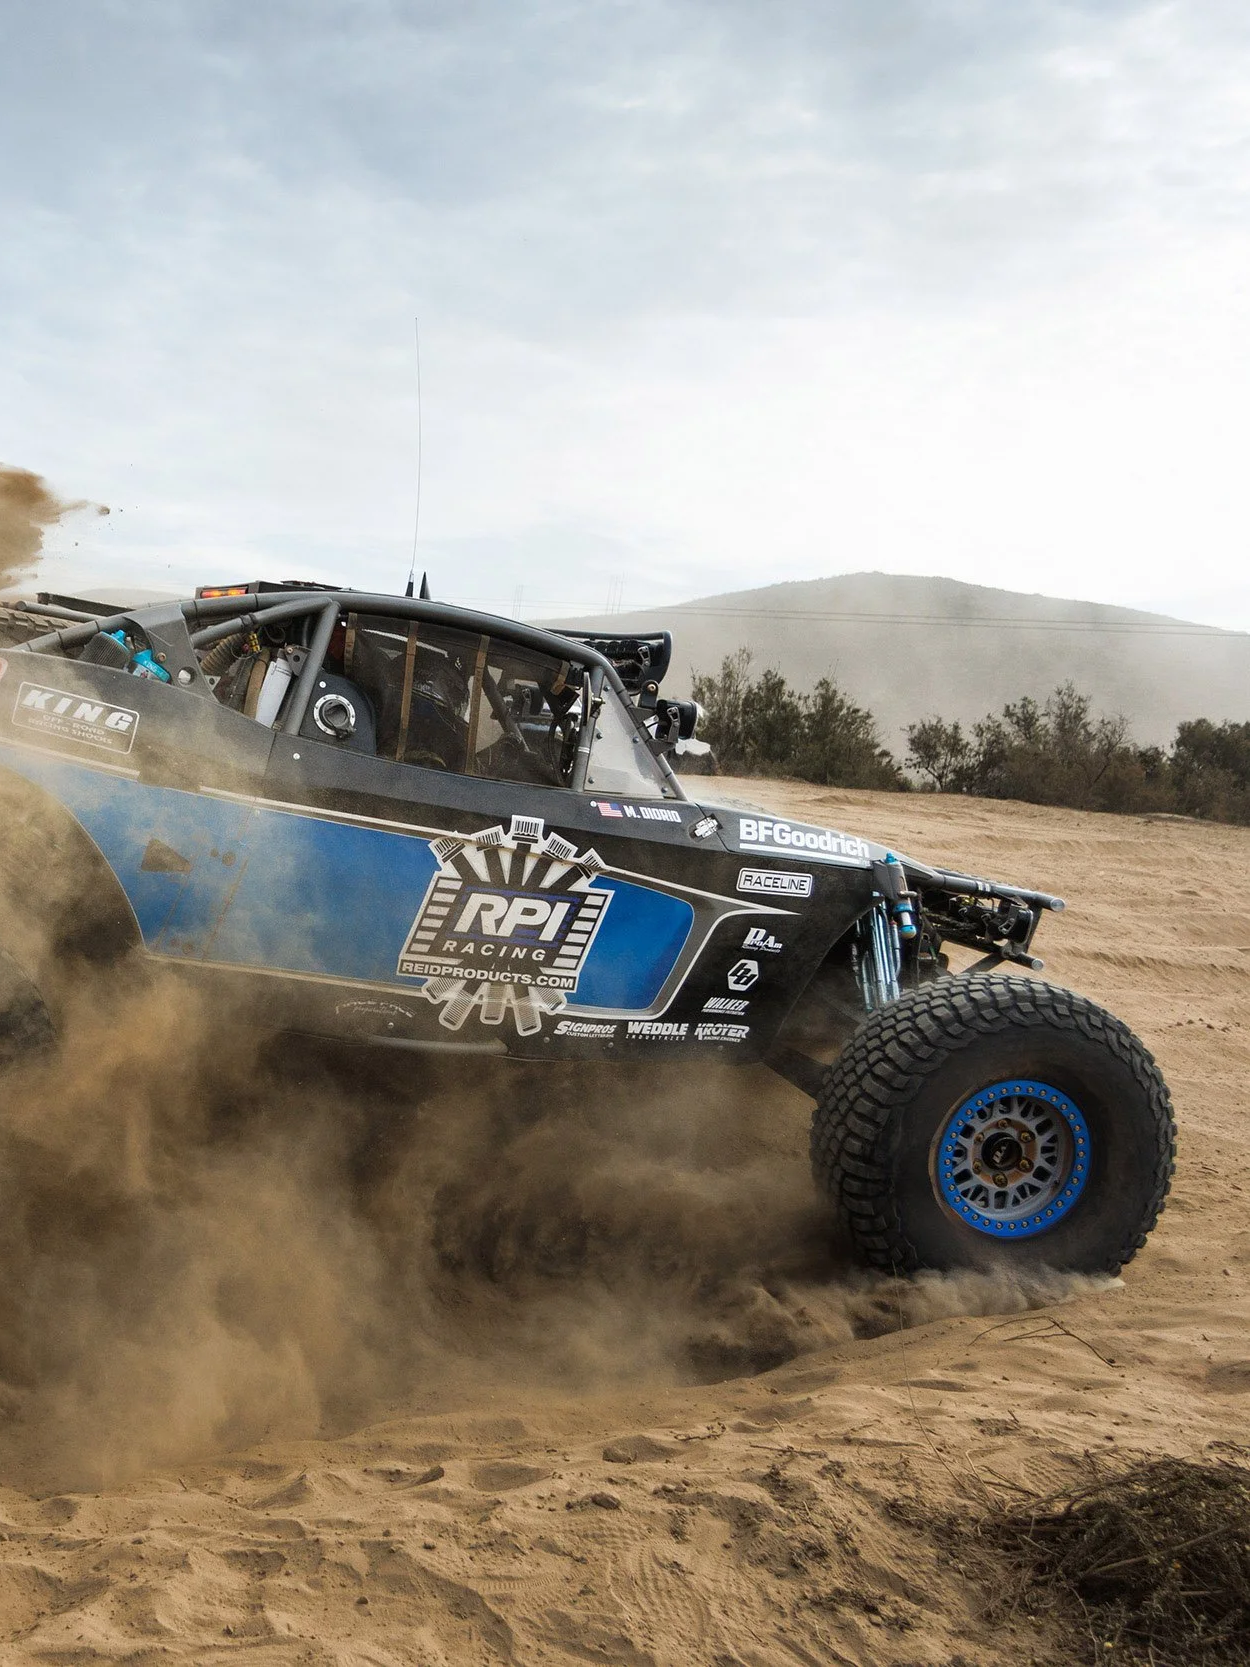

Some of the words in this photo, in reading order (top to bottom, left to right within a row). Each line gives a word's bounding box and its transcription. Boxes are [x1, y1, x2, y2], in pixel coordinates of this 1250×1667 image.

[21, 689, 134, 731] KING
[623, 805, 641, 818] M.
[739, 818, 870, 858] BFGoodrich
[743, 874, 808, 891] RACELINE
[453, 892, 571, 942] RPI
[442, 940, 546, 961] RACING
[401, 962, 575, 989] REIDPRODUCTS.COM
[703, 996, 750, 1011] WALKER
[553, 1020, 617, 1035] SIGNPROS
[627, 1021, 690, 1036] WEDDLE
